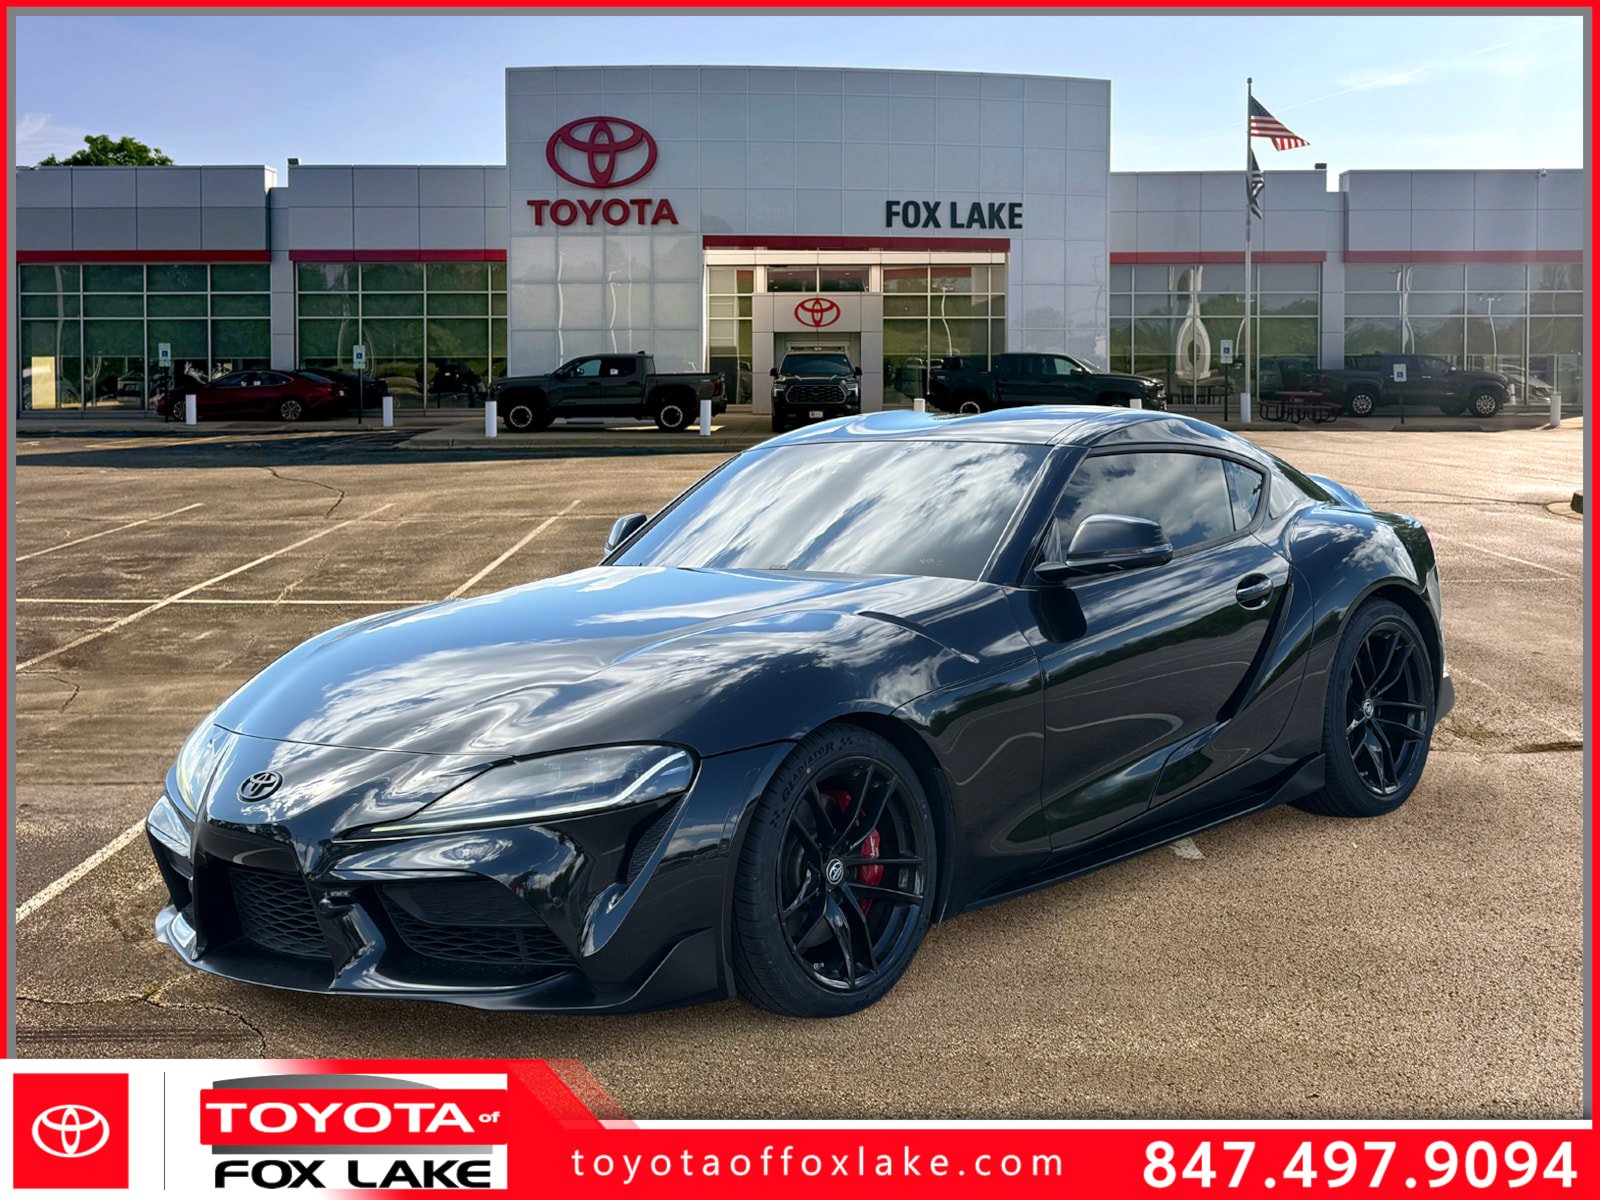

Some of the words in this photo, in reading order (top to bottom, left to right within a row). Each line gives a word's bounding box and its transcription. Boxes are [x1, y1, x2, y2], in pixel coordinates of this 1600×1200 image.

[527, 198, 679, 226] TOYOTA
[885, 200, 942, 229] FOX
[950, 201, 1024, 230] LAKE
[783, 743, 834, 798] GLADIATOR
